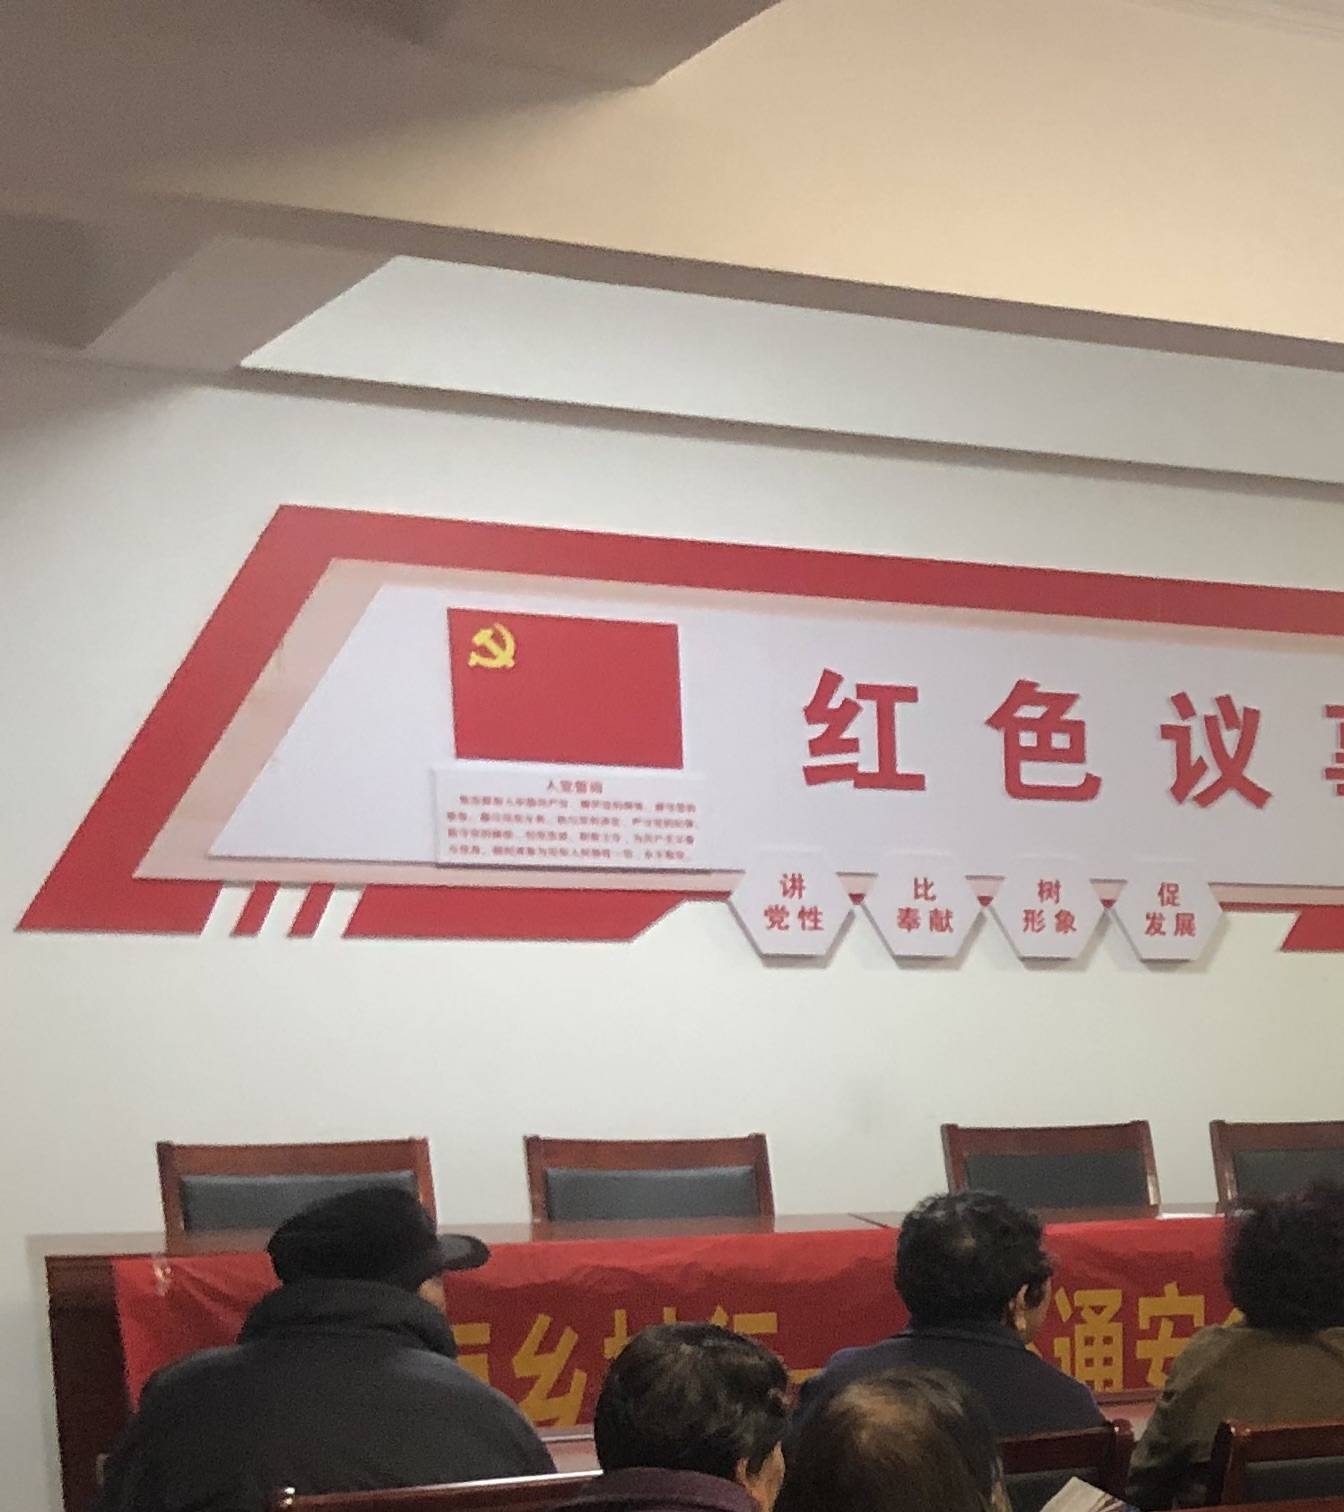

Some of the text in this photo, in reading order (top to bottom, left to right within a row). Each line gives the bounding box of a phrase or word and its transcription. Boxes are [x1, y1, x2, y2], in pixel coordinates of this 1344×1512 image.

[780, 873, 806, 900] 讲
[913, 877, 937, 901] 比
[1037, 879, 1061, 904] 树
[1157, 882, 1181, 907] 促
[764, 904, 825, 931] 党性
[897, 907, 954, 933] 奉献
[1023, 908, 1077, 934] 形象
[1145, 912, 1196, 937] 发展
